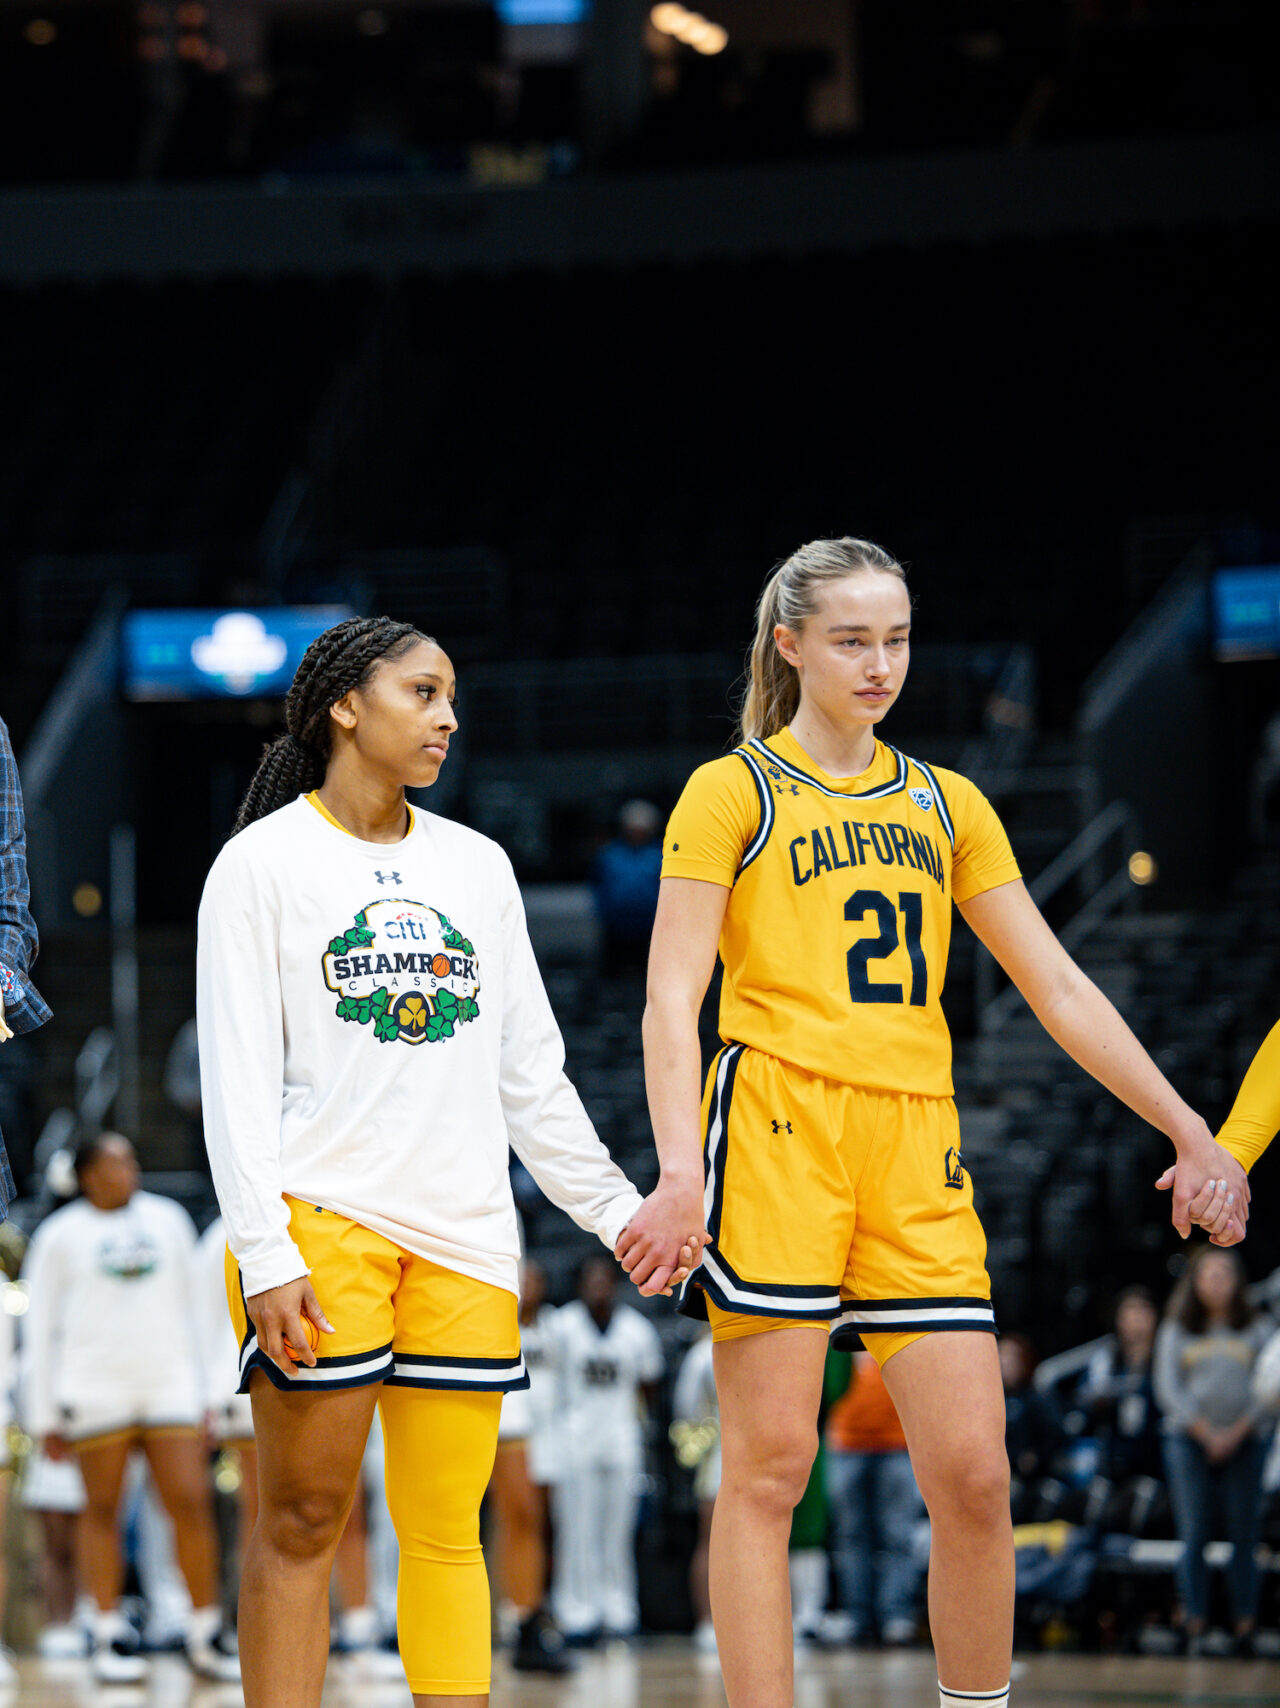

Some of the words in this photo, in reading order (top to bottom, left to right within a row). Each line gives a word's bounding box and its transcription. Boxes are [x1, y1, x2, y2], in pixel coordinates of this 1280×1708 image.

[789, 821, 945, 894] CALIFORNIA
[384, 917, 427, 940] citi
[844, 889, 928, 1007] 21
[333, 952, 476, 980] SHAMROCK
[348, 976, 469, 992] CLASSIC
